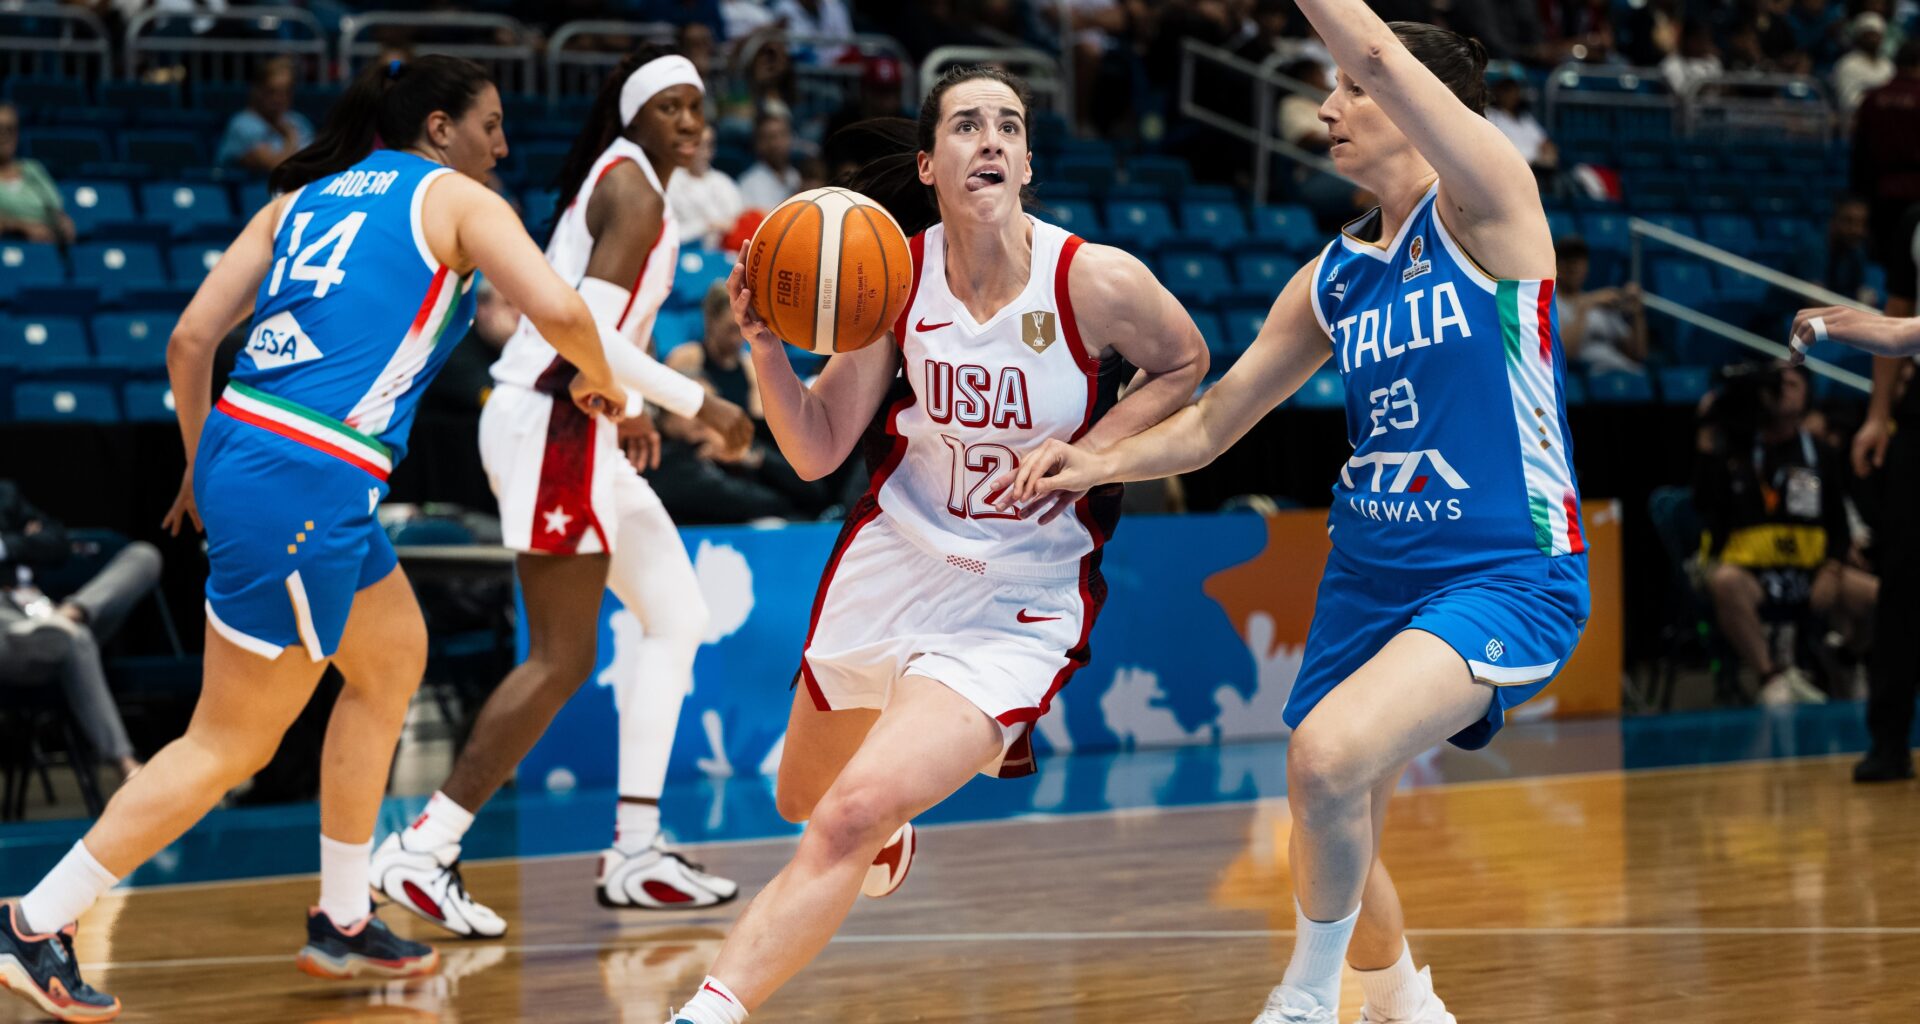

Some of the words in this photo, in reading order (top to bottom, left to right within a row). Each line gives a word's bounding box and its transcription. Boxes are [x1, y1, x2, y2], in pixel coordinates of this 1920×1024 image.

[268, 211, 367, 299] 14
[777, 269, 793, 307] FIBA
[1330, 281, 1472, 374] TALIA
[925, 359, 1032, 429] USA
[1370, 377, 1419, 437] 23
[940, 434, 1022, 519] 12
